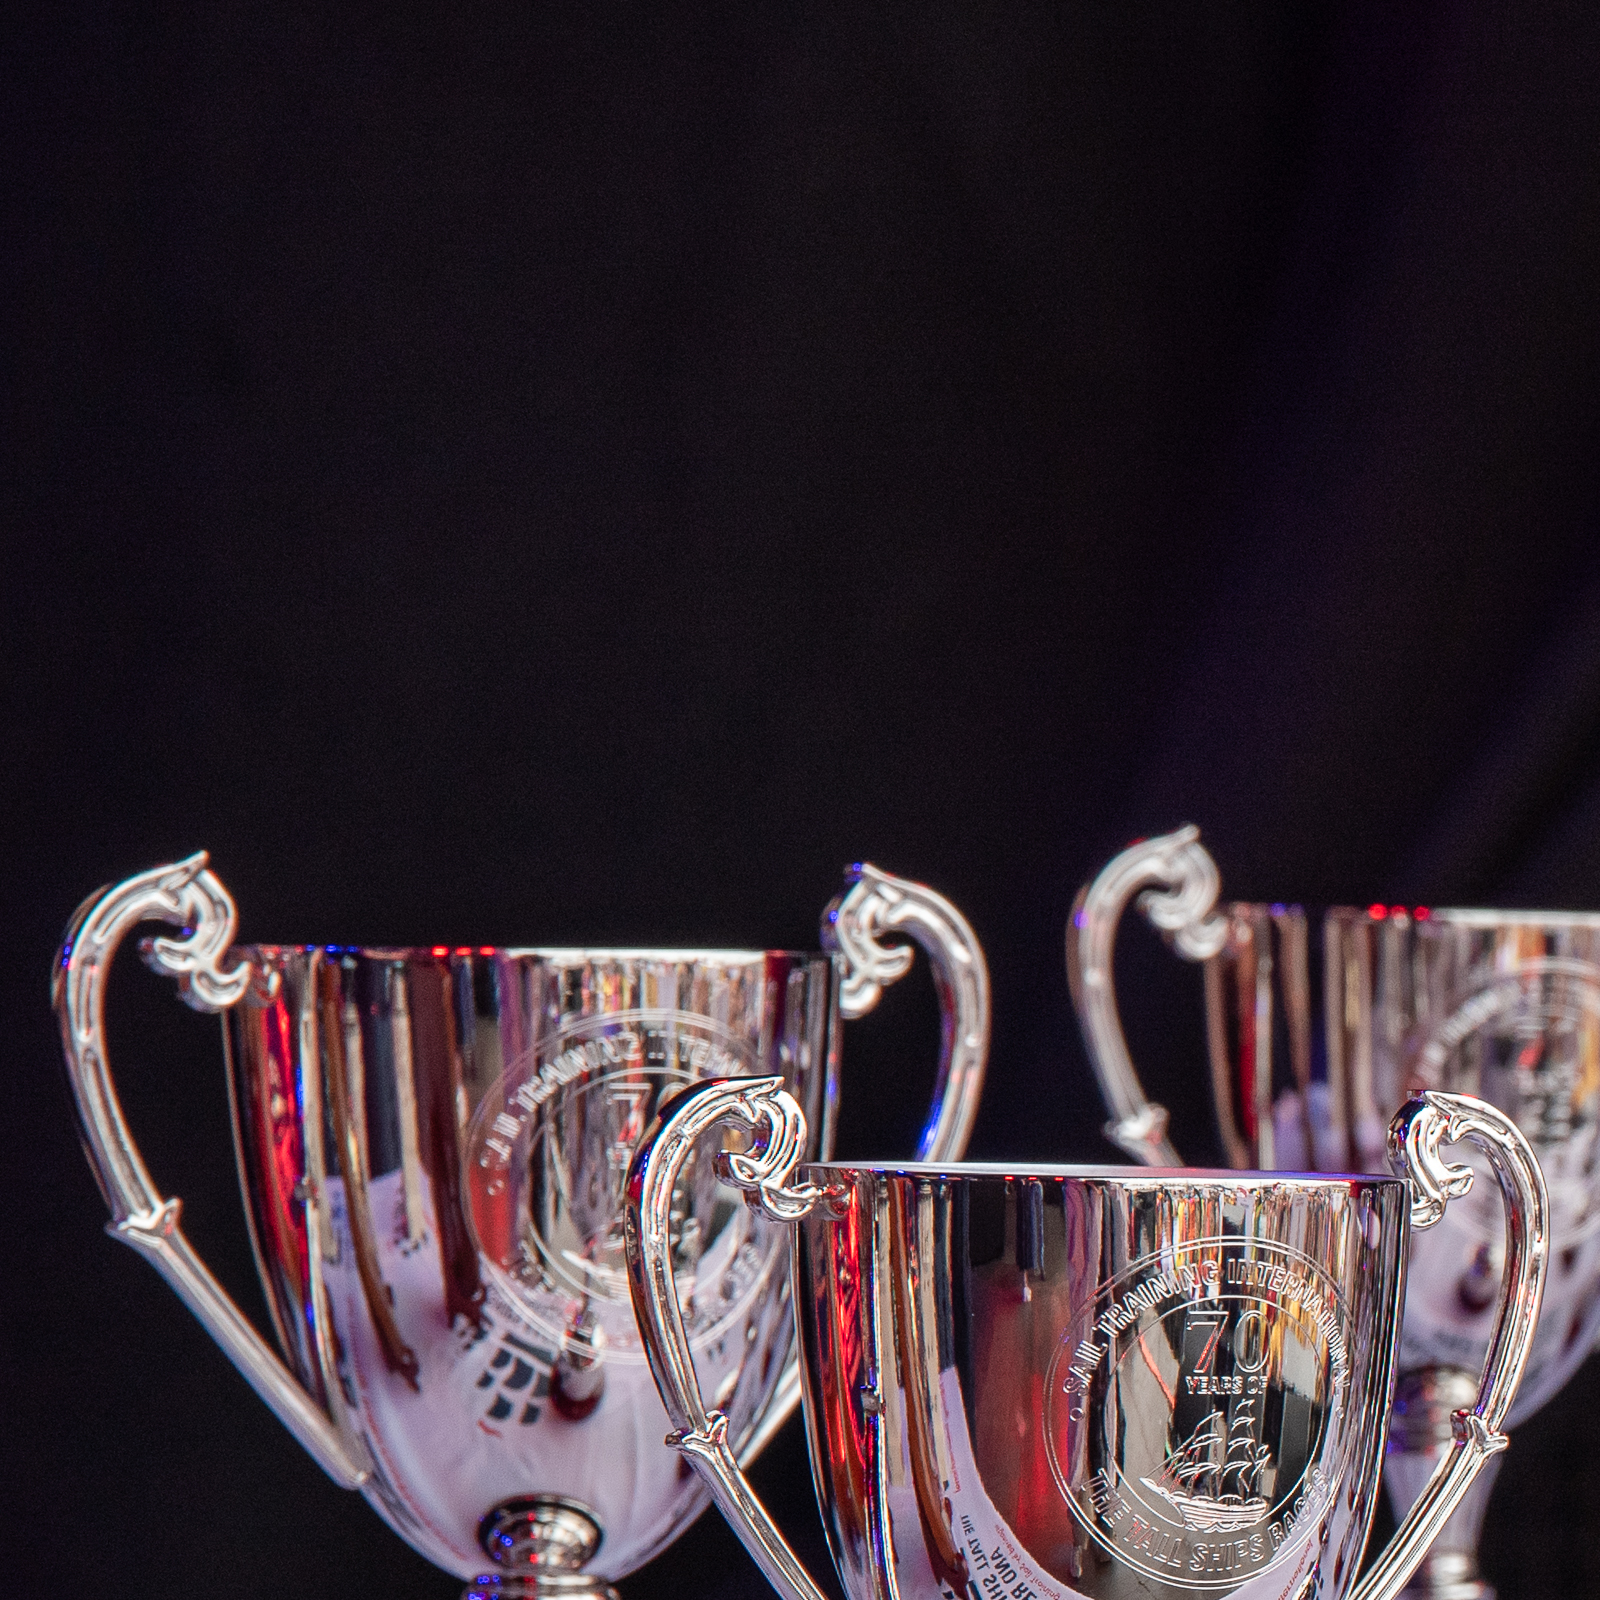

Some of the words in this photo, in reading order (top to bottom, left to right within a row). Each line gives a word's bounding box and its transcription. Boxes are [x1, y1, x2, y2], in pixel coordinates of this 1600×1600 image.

[1062, 1333, 1108, 1397] SAIL
[1092, 1258, 1221, 1345] TRAINING
[1227, 1257, 1351, 1389] INTERNATIONAL
[1185, 1310, 1272, 1374] 70
[1185, 1375, 1243, 1396] YEARS
[1246, 1375, 1269, 1395] OF
[1123, 1516, 1182, 1569] TALL
[1189, 1533, 1265, 1573] SHIPS
[1267, 1466, 1330, 1551] RACES
